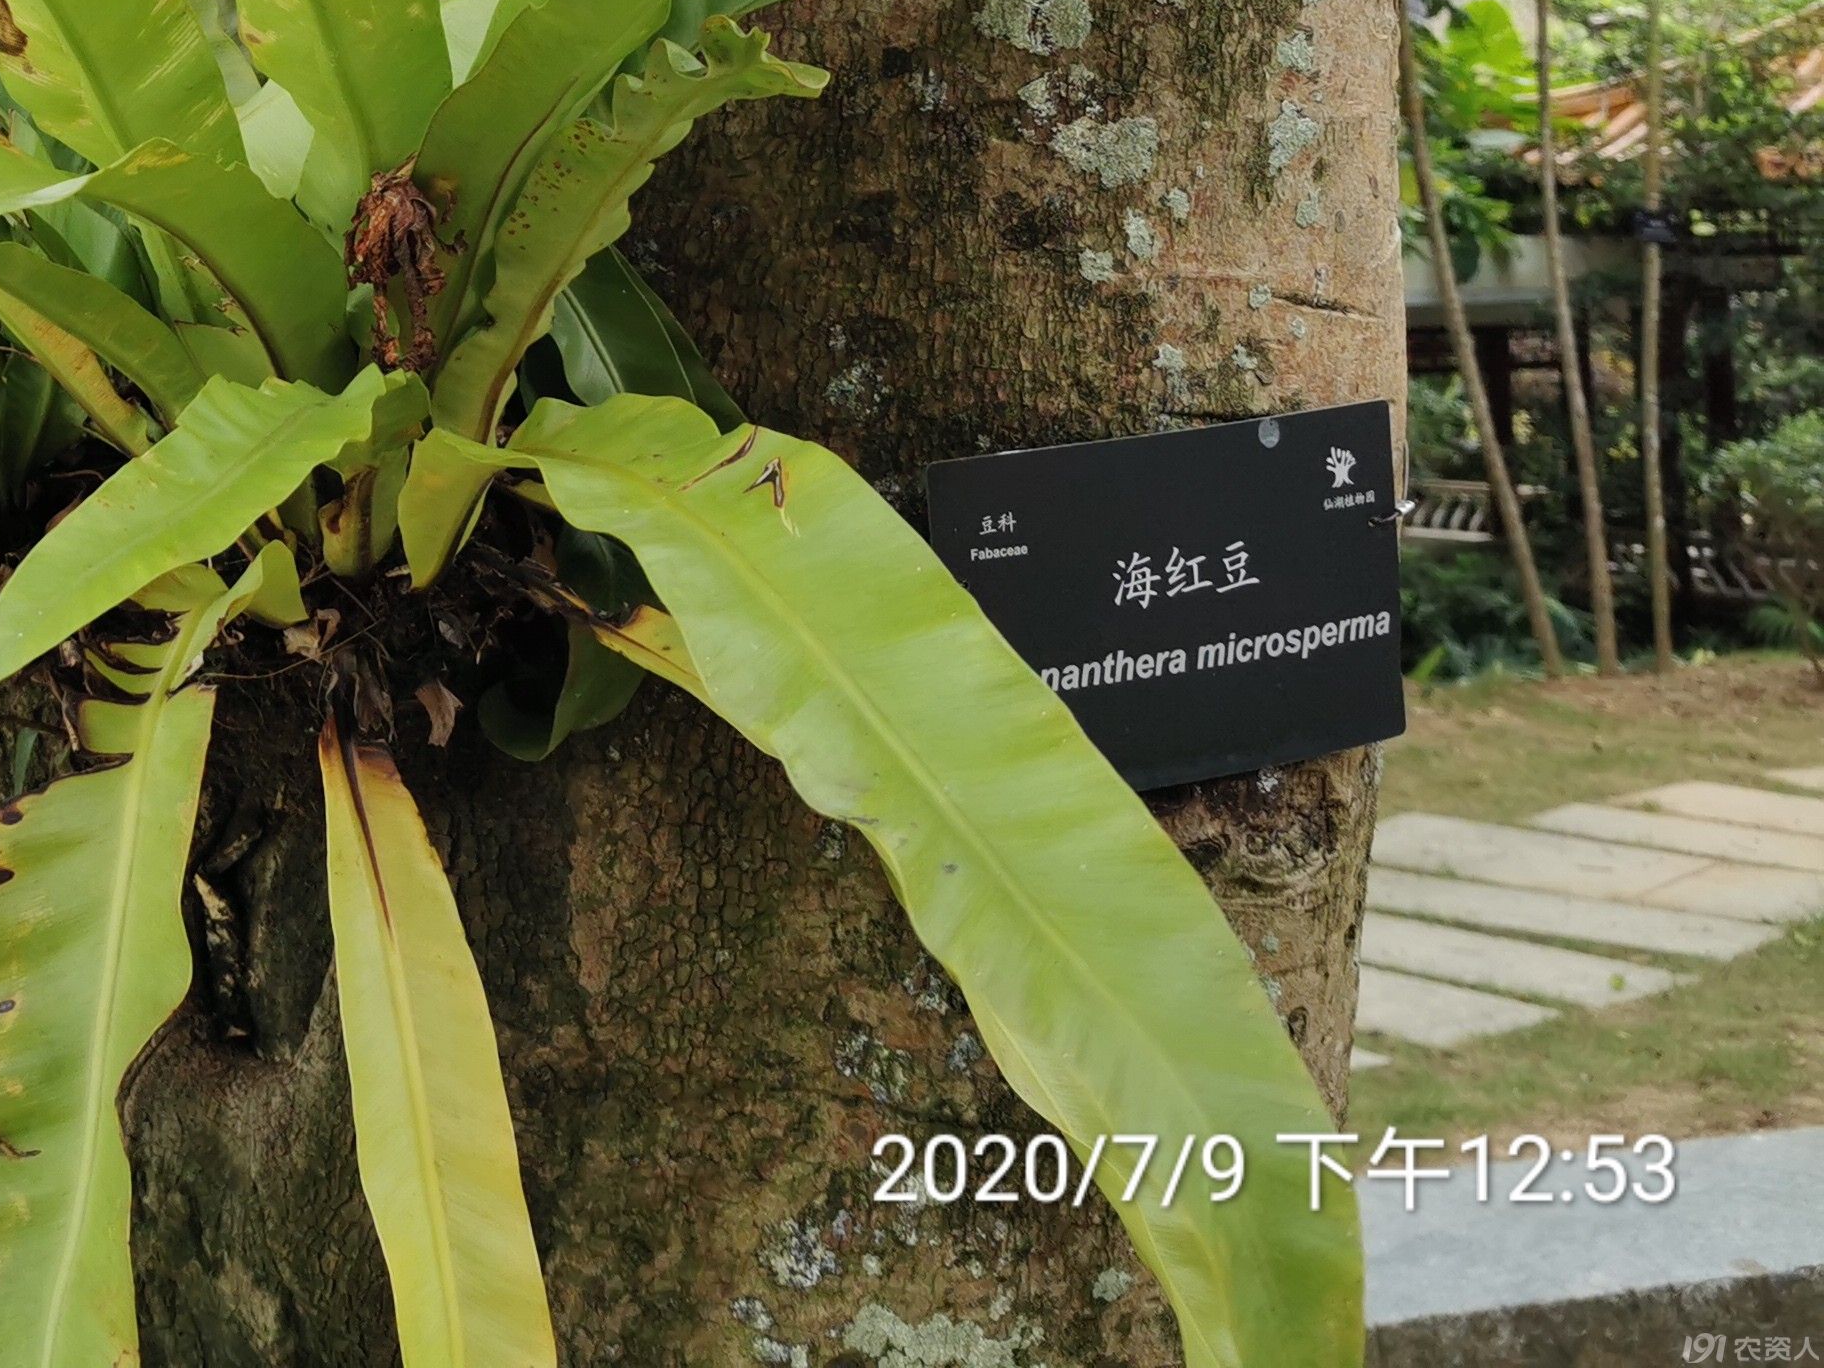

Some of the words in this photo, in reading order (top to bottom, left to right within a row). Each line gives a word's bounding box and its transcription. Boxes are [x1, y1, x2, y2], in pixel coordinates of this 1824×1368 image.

[1323, 490, 1376, 511] 仙湖植物园
[979, 512, 1017, 536] 豆科
[970, 543, 1028, 561] Fabaceae
[1112, 540, 1261, 609] 海红豆
[1197, 611, 1391, 671] microsperma
